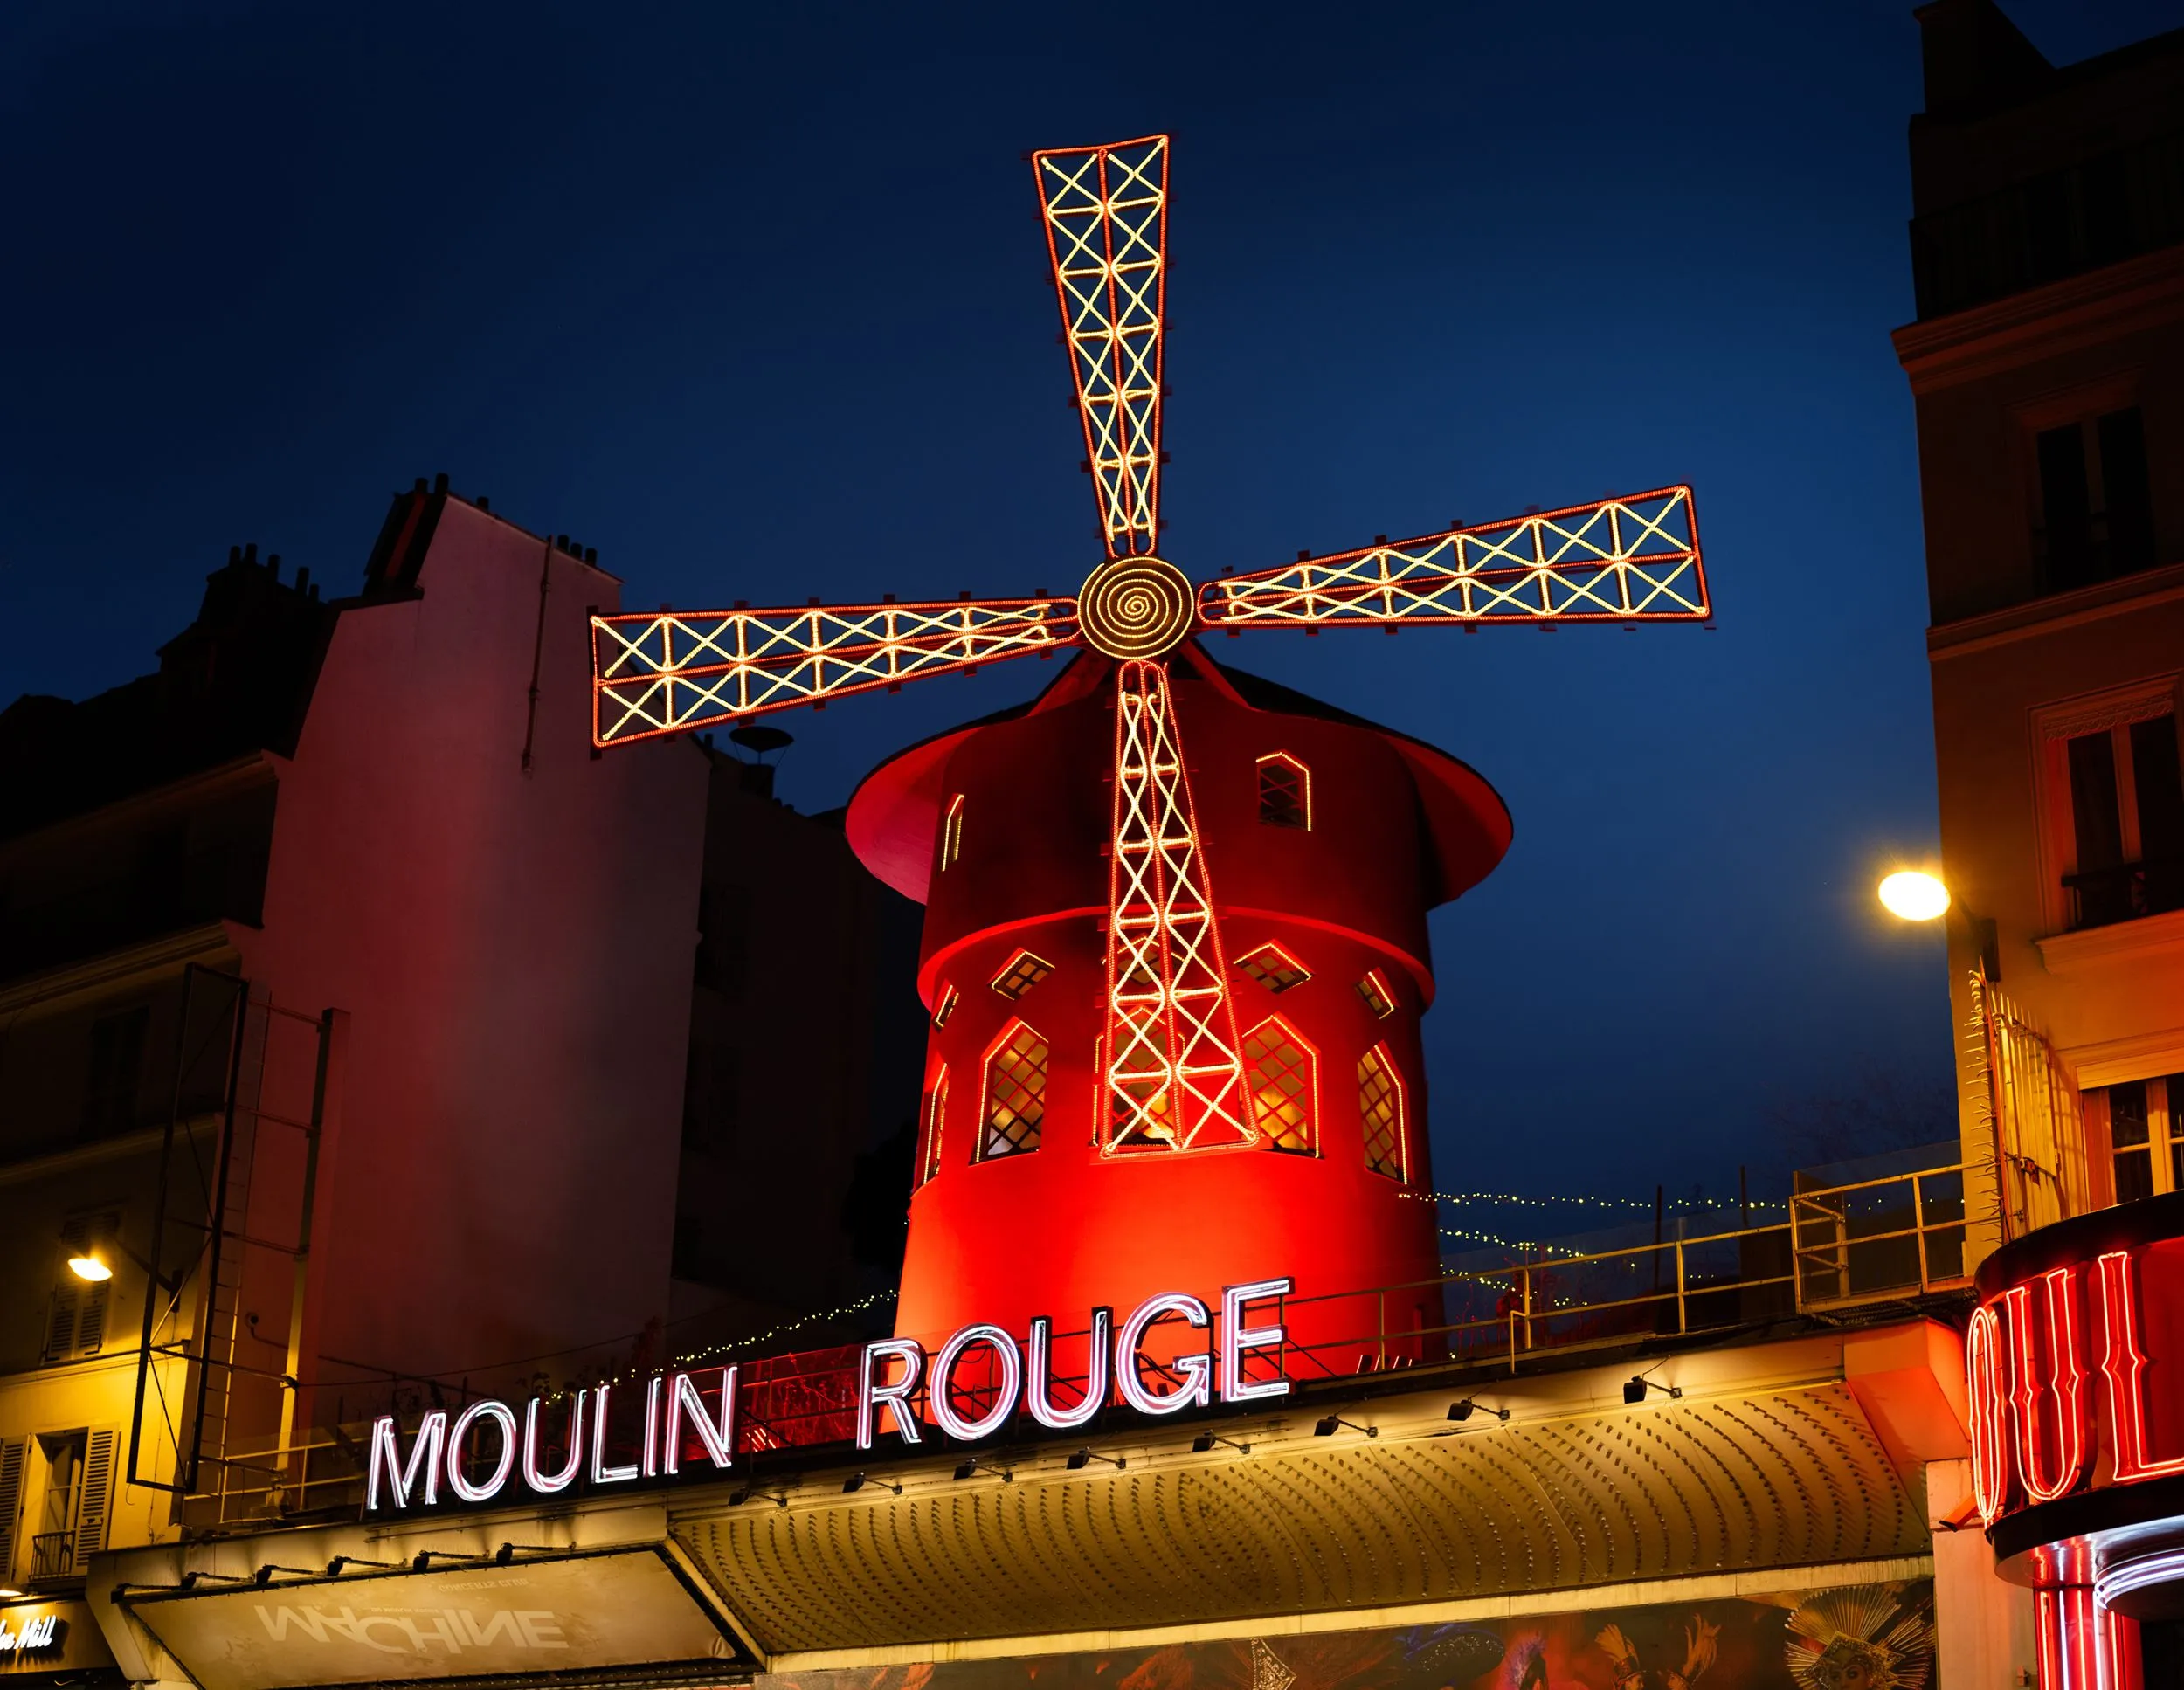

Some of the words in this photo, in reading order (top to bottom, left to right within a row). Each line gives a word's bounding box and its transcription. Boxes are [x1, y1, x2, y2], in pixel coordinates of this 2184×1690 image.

[367, 1362, 737, 1511] MOULIN
[855, 1276, 1295, 1451] ROUGE
[14, 1615, 57, 1649] Mill
